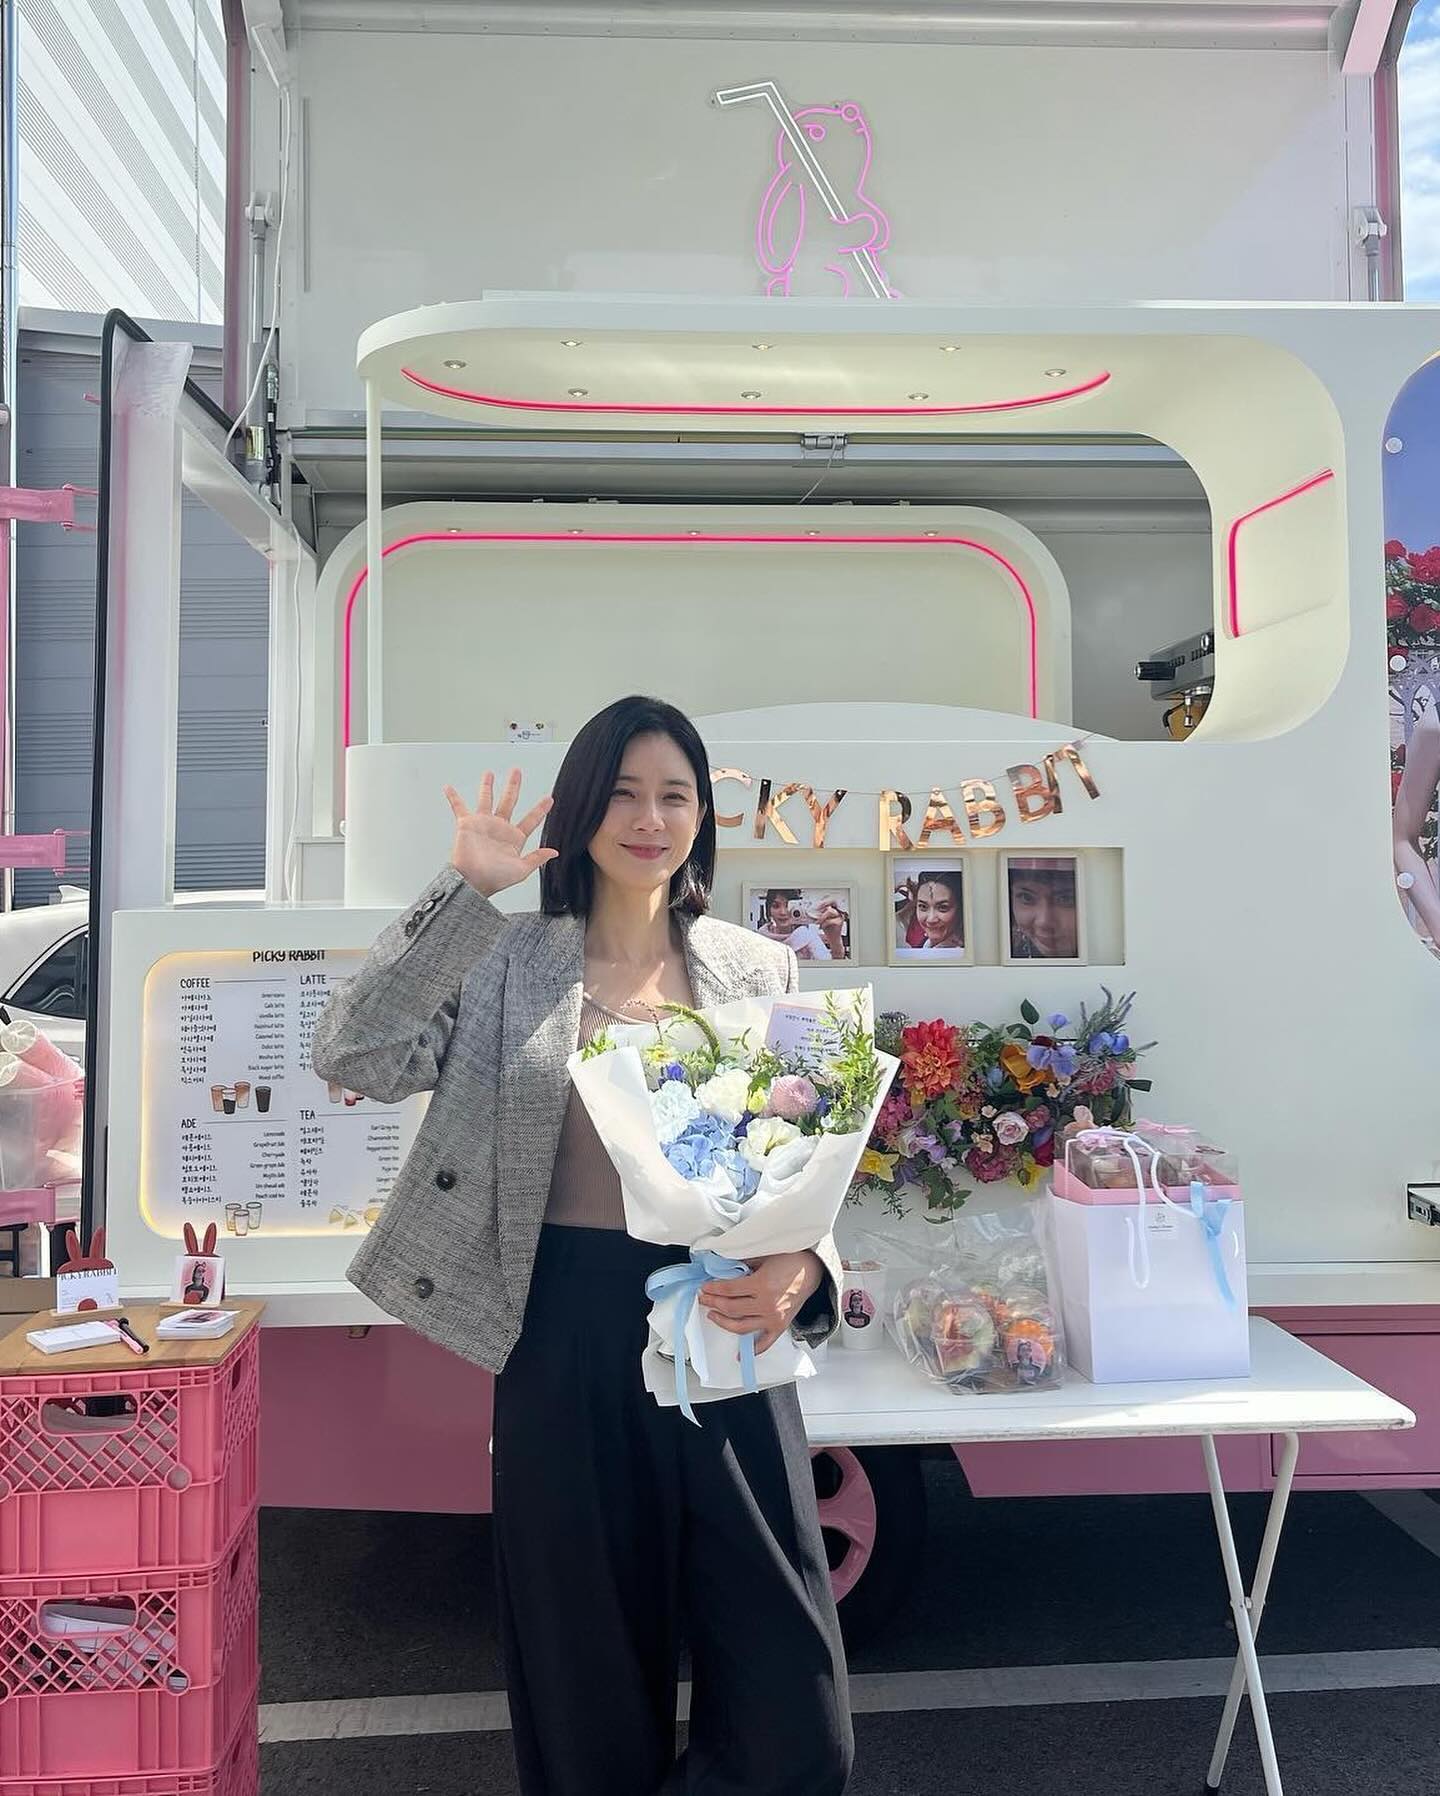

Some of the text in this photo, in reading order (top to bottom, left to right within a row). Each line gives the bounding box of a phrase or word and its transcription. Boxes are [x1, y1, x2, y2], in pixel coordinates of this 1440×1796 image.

[879, 739, 1101, 852] RABBIT
[252, 949, 326, 962] PICKY RABBIT
[180, 978, 211, 989] COFFEE
[299, 974, 327, 985] LATTE
[300, 1110, 316, 1120] TEA
[181, 1118, 197, 1128] ADE
